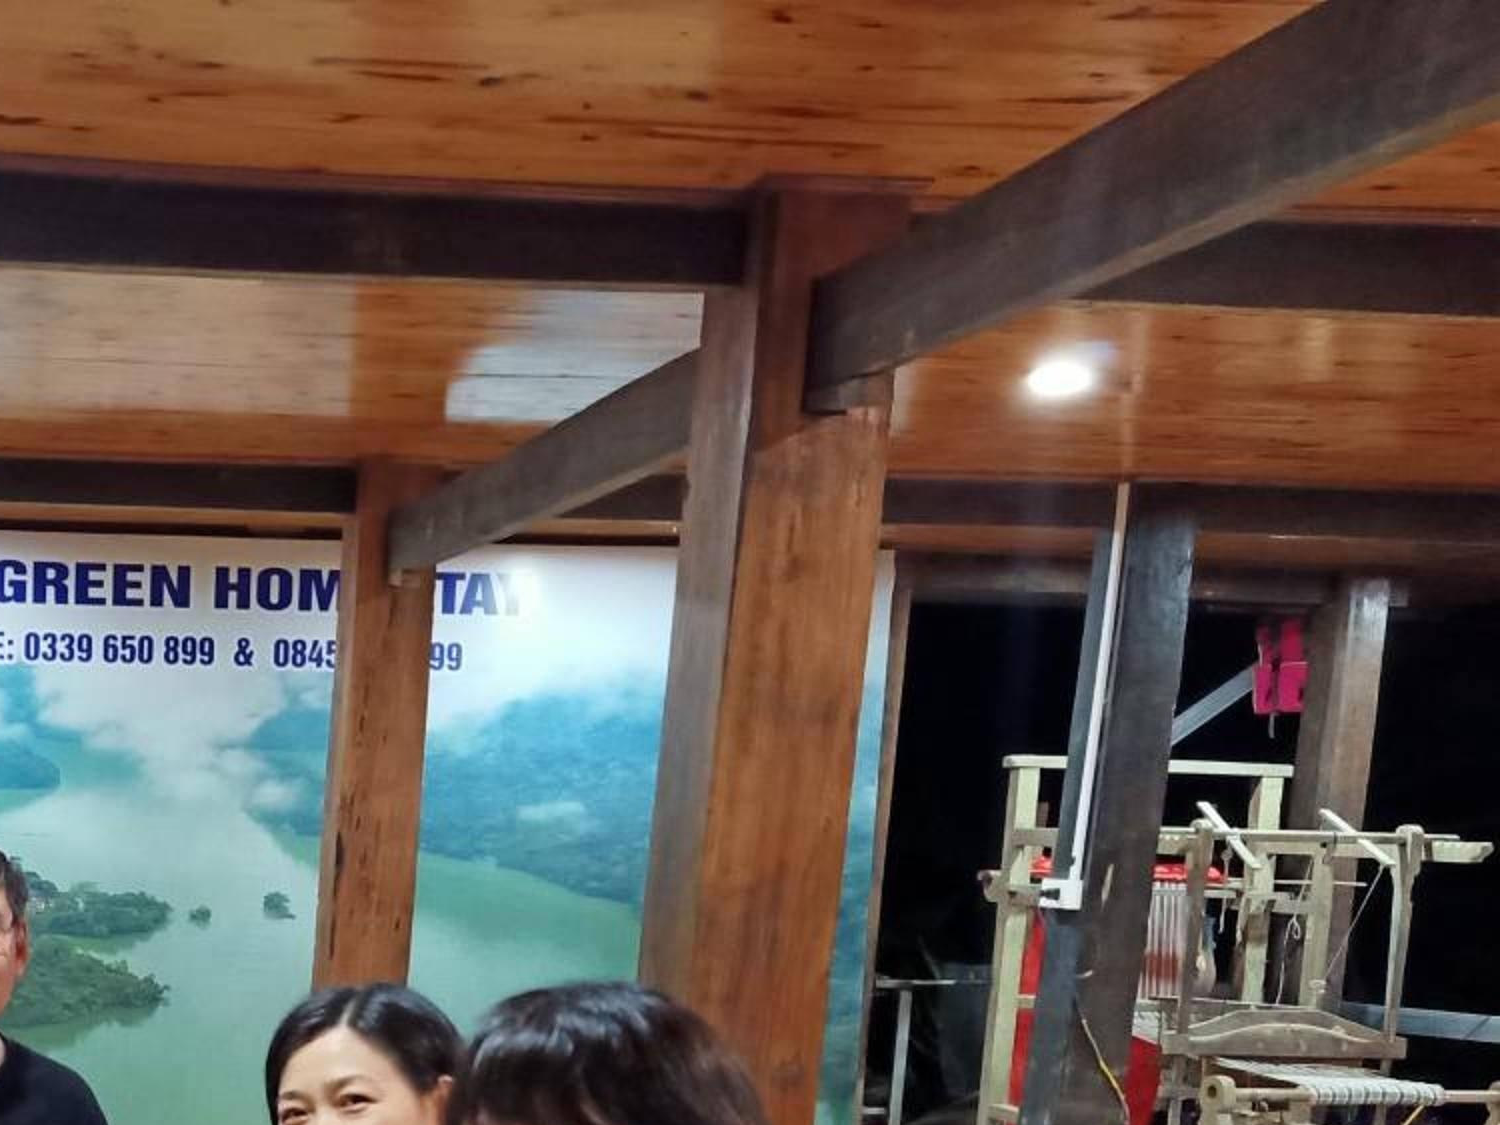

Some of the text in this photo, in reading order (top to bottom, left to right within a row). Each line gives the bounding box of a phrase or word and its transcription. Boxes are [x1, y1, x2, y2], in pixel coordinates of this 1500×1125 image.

[23, 632, 93, 663] 0339
[102, 635, 154, 665] 650
[162, 636, 216, 666] 899
[233, 638, 254, 667] &
